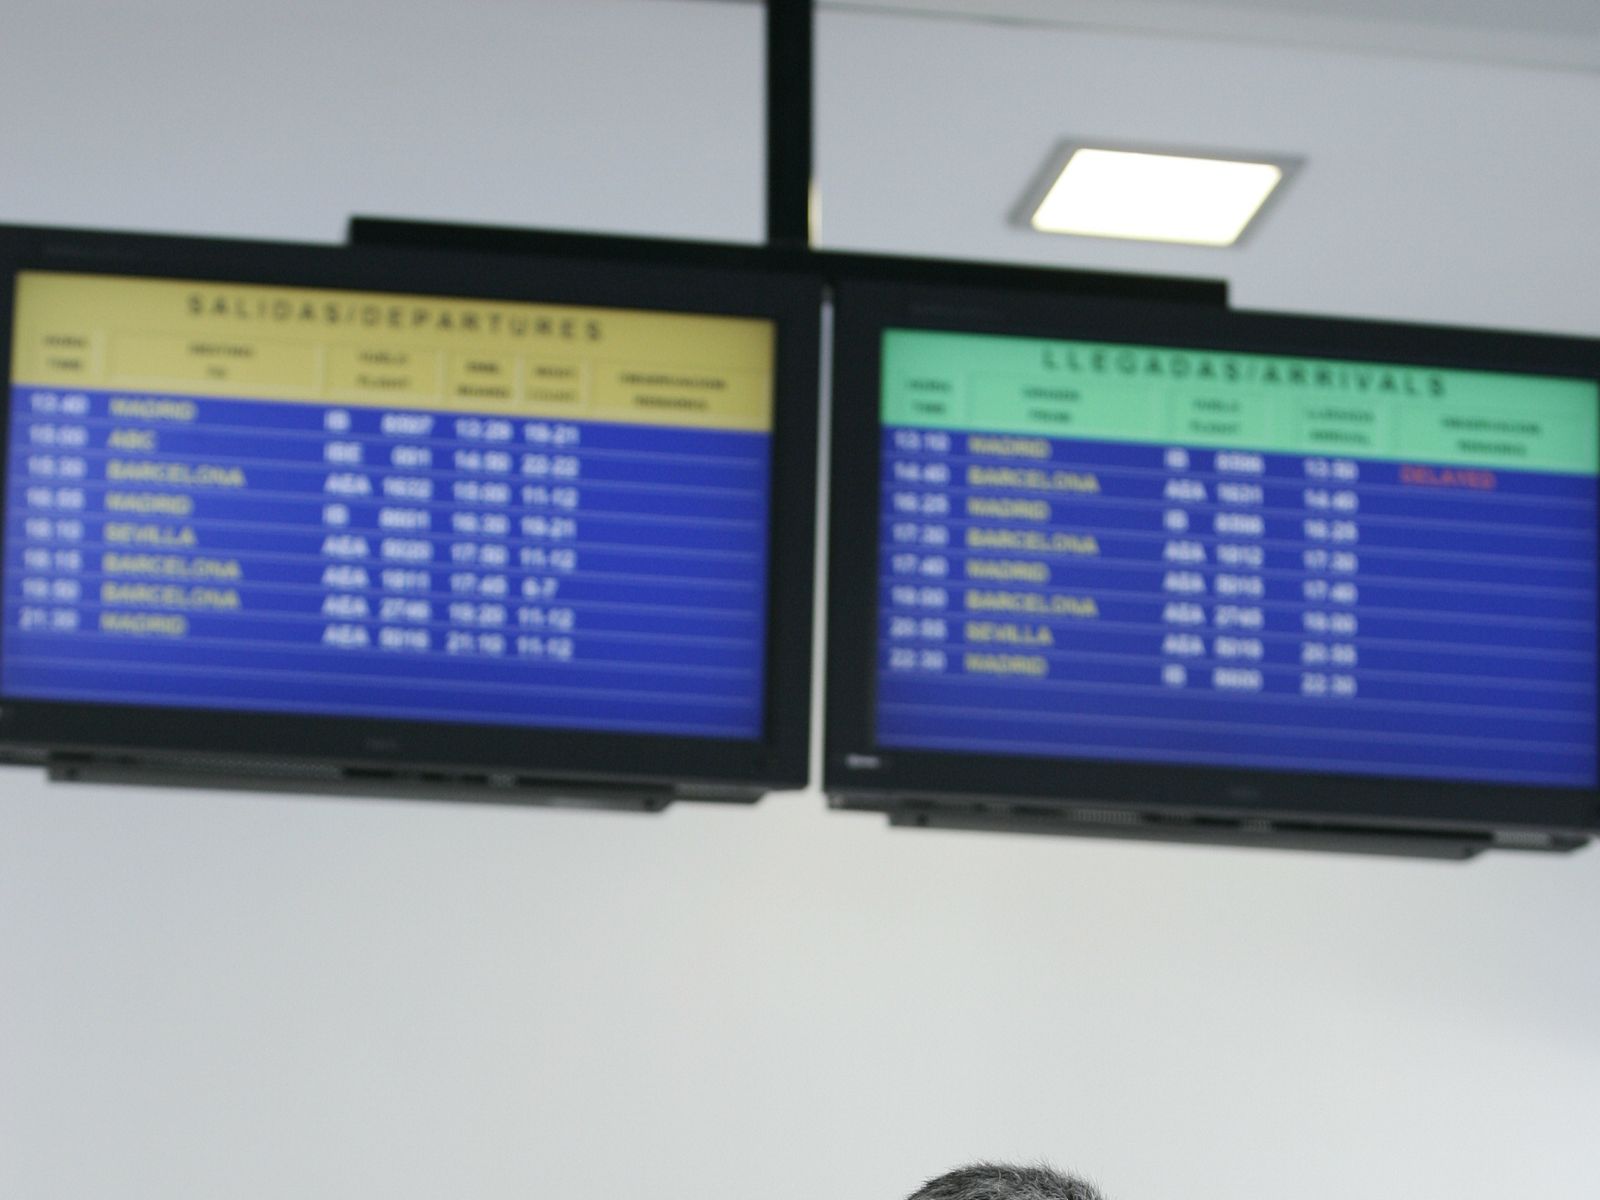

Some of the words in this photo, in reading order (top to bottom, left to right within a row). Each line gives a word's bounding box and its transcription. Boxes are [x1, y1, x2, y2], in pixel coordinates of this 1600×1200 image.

[187, 293, 605, 342] SALIDAS/DEPARTURES
[1041, 346, 1445, 398] LLEGADAS/ARRIVALS
[109, 399, 195, 421] MADRID
[107, 462, 245, 487] BARCELONA
[968, 438, 1049, 458] MADRID
[1400, 465, 1496, 488] DELAYED
[967, 468, 1100, 493] BARCELONA
[105, 493, 191, 515] MADRID
[967, 498, 1049, 520] MADRID
[102, 523, 197, 548] SEVILLA
[966, 529, 1099, 555] BARCELONA
[102, 556, 242, 579] BARCELONA
[966, 561, 1048, 582] MADRID
[100, 584, 240, 609] BARCELONA
[965, 591, 1098, 617] BARCELONA
[100, 613, 185, 635] MADRID
[963, 623, 1054, 646] SEVILLA
[965, 655, 1047, 675] MADRID
